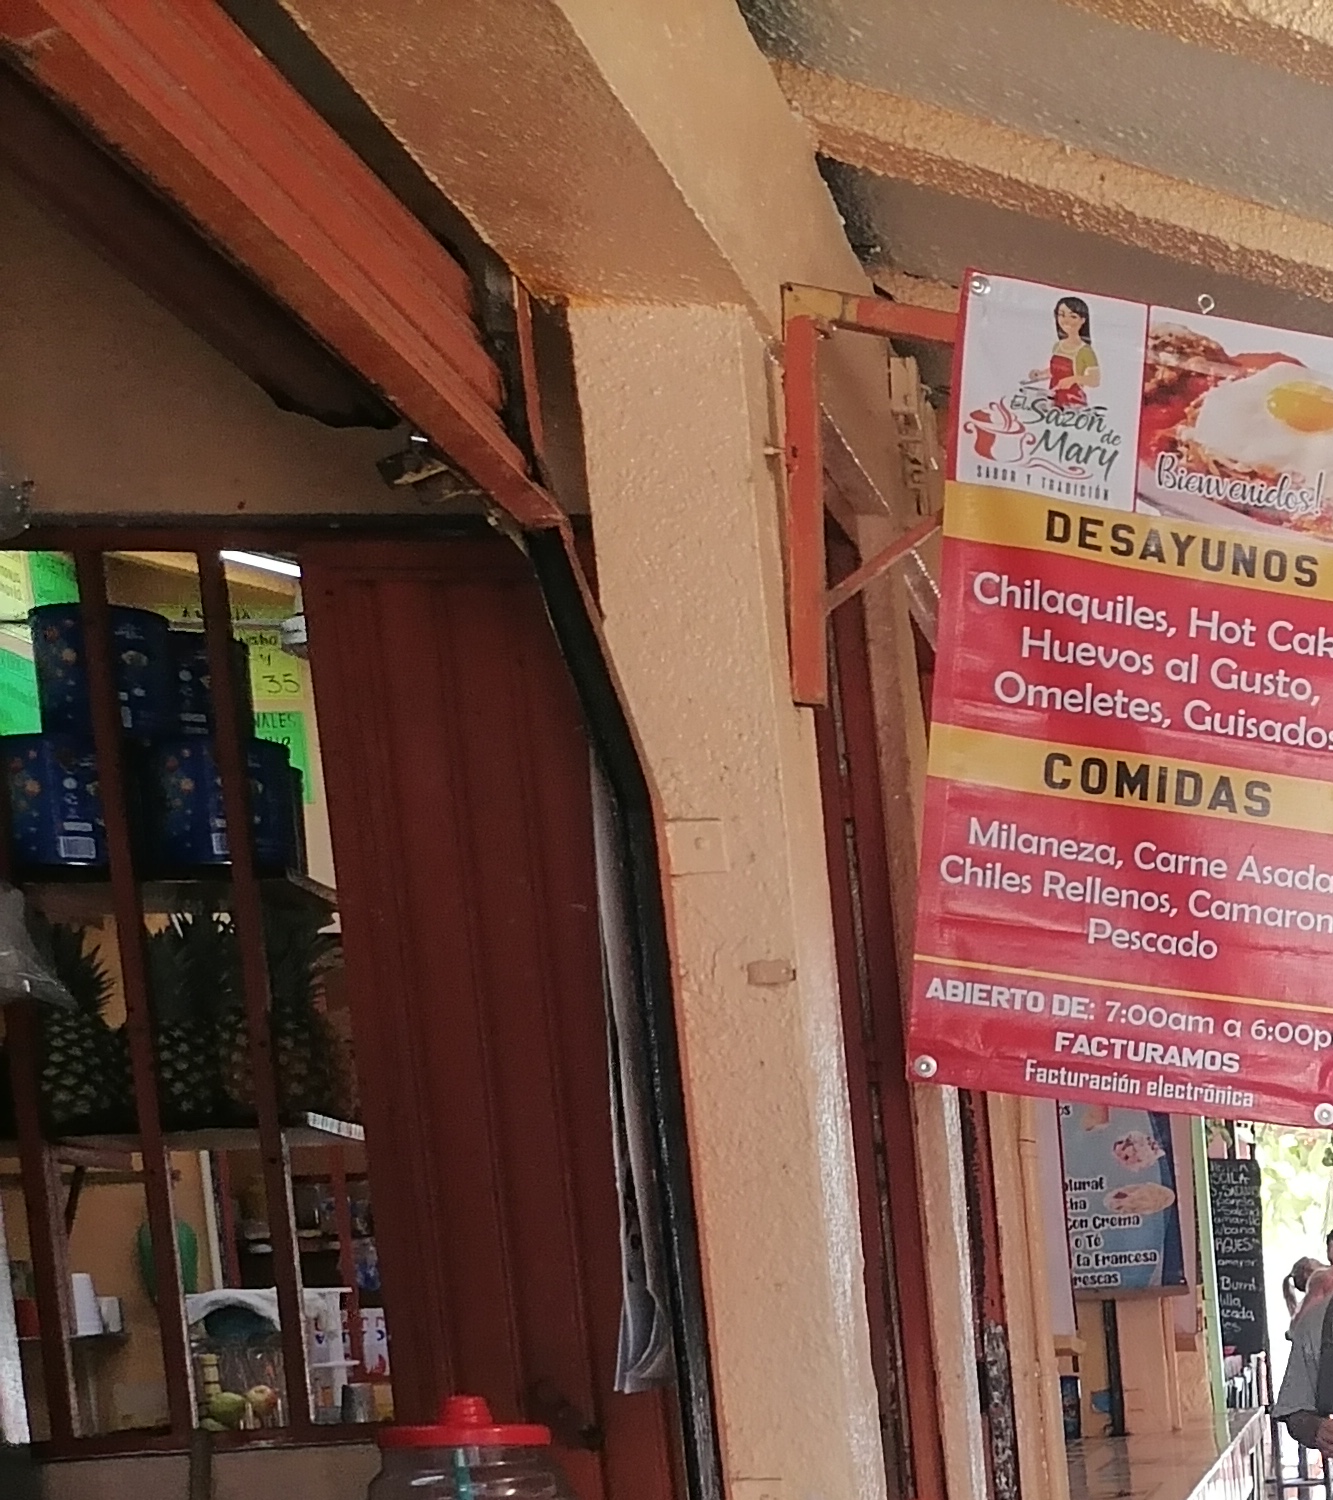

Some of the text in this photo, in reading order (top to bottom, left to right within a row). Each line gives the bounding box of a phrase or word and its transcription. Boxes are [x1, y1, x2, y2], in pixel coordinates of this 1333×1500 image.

[1031, 429, 1121, 480] Mary
[1101, 429, 1122, 447] de
[976, 465, 1111, 502] SABOR Y TRADICIÓN
[1155, 452, 1325, 515] Bienvenidos!
[1044, 509, 1320, 589] DESAYUNOS
[972, 571, 1177, 638] Chilaquiles,
[1188, 607, 1257, 648] Hot
[1021, 627, 1321, 705] Huevos al Gusto,
[993, 670, 1172, 730] Omeletes,
[1042, 752, 1273, 818] COMIDAS
[968, 817, 1125, 870] Milaneza,
[1133, 841, 1228, 881] Carne
[939, 854, 1033, 894] Chiles
[1043, 872, 1179, 919] Rellenos,
[1087, 918, 1219, 961] Pescado
[926, 978, 1046, 1015] ABIERTO
[1051, 993, 1097, 1021] DE:
[1104, 1001, 1215, 1037] 7:00am
[1222, 1016, 1242, 1039] a
[1053, 1031, 1240, 1073] FACTURAMOS
[1024, 1059, 1255, 1109] Facturación electrónica
[1085, 1234, 1102, 1249] Té
[1092, 1214, 1141, 1230] Crema
[1095, 1250, 1158, 1266] Francesa
